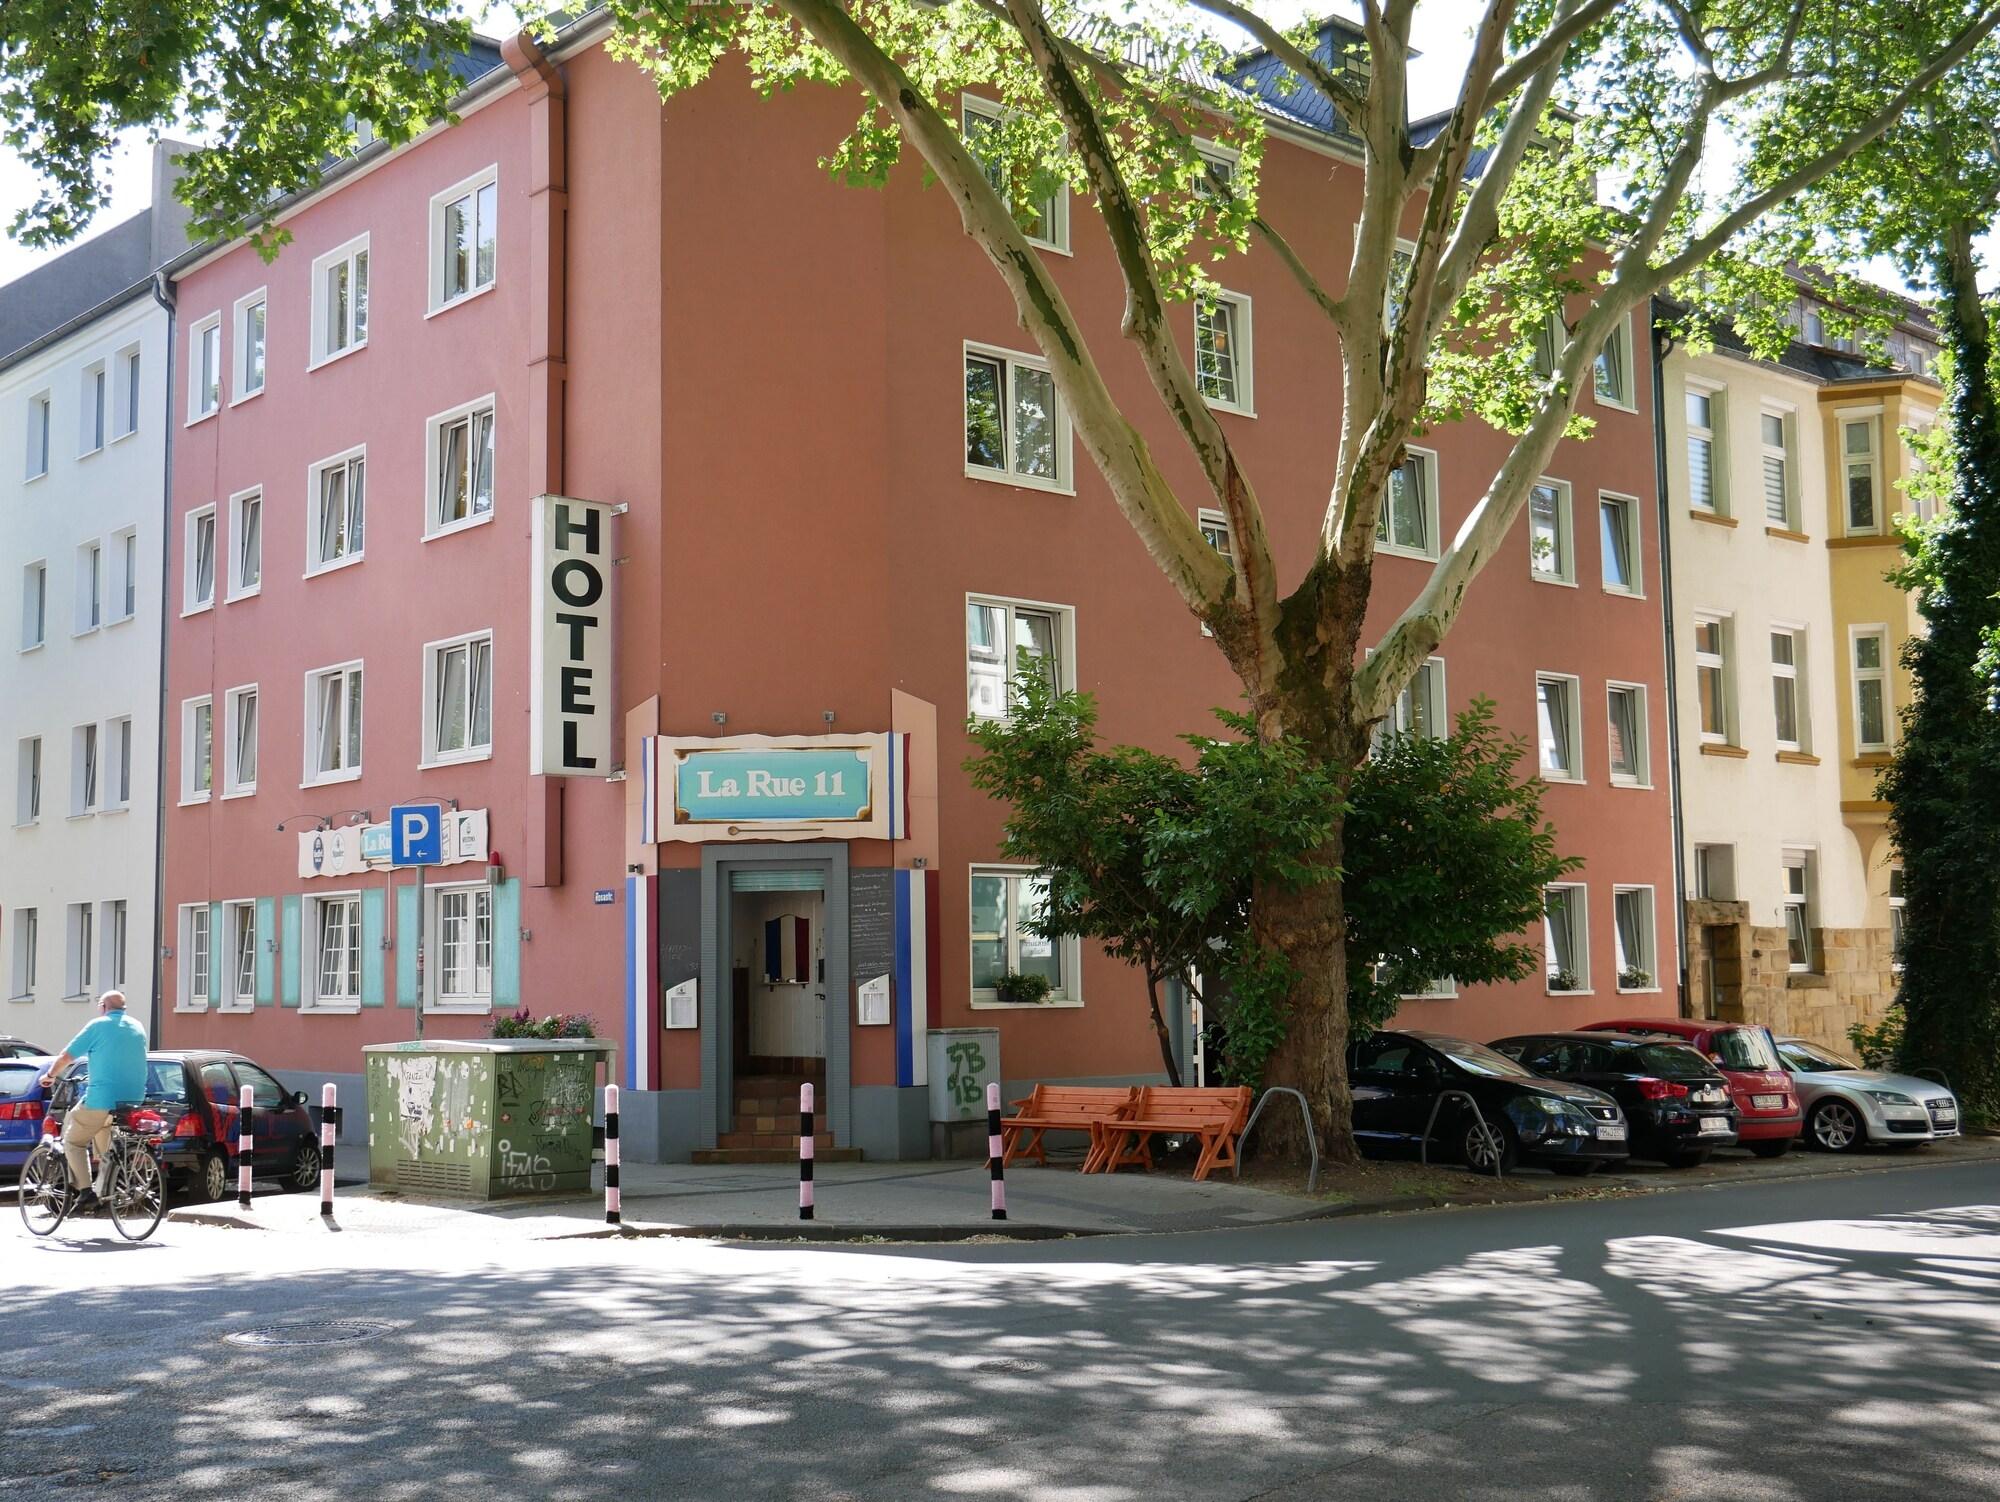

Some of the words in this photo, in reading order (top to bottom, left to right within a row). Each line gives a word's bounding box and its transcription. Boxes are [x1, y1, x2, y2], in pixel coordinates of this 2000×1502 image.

[551, 504, 603, 769] HOTEL
[697, 770, 740, 798] La
[746, 770, 806, 798] Rue
[813, 771, 846, 796] 11
[378, 831, 391, 850] Ru
[403, 813, 429, 858] P
